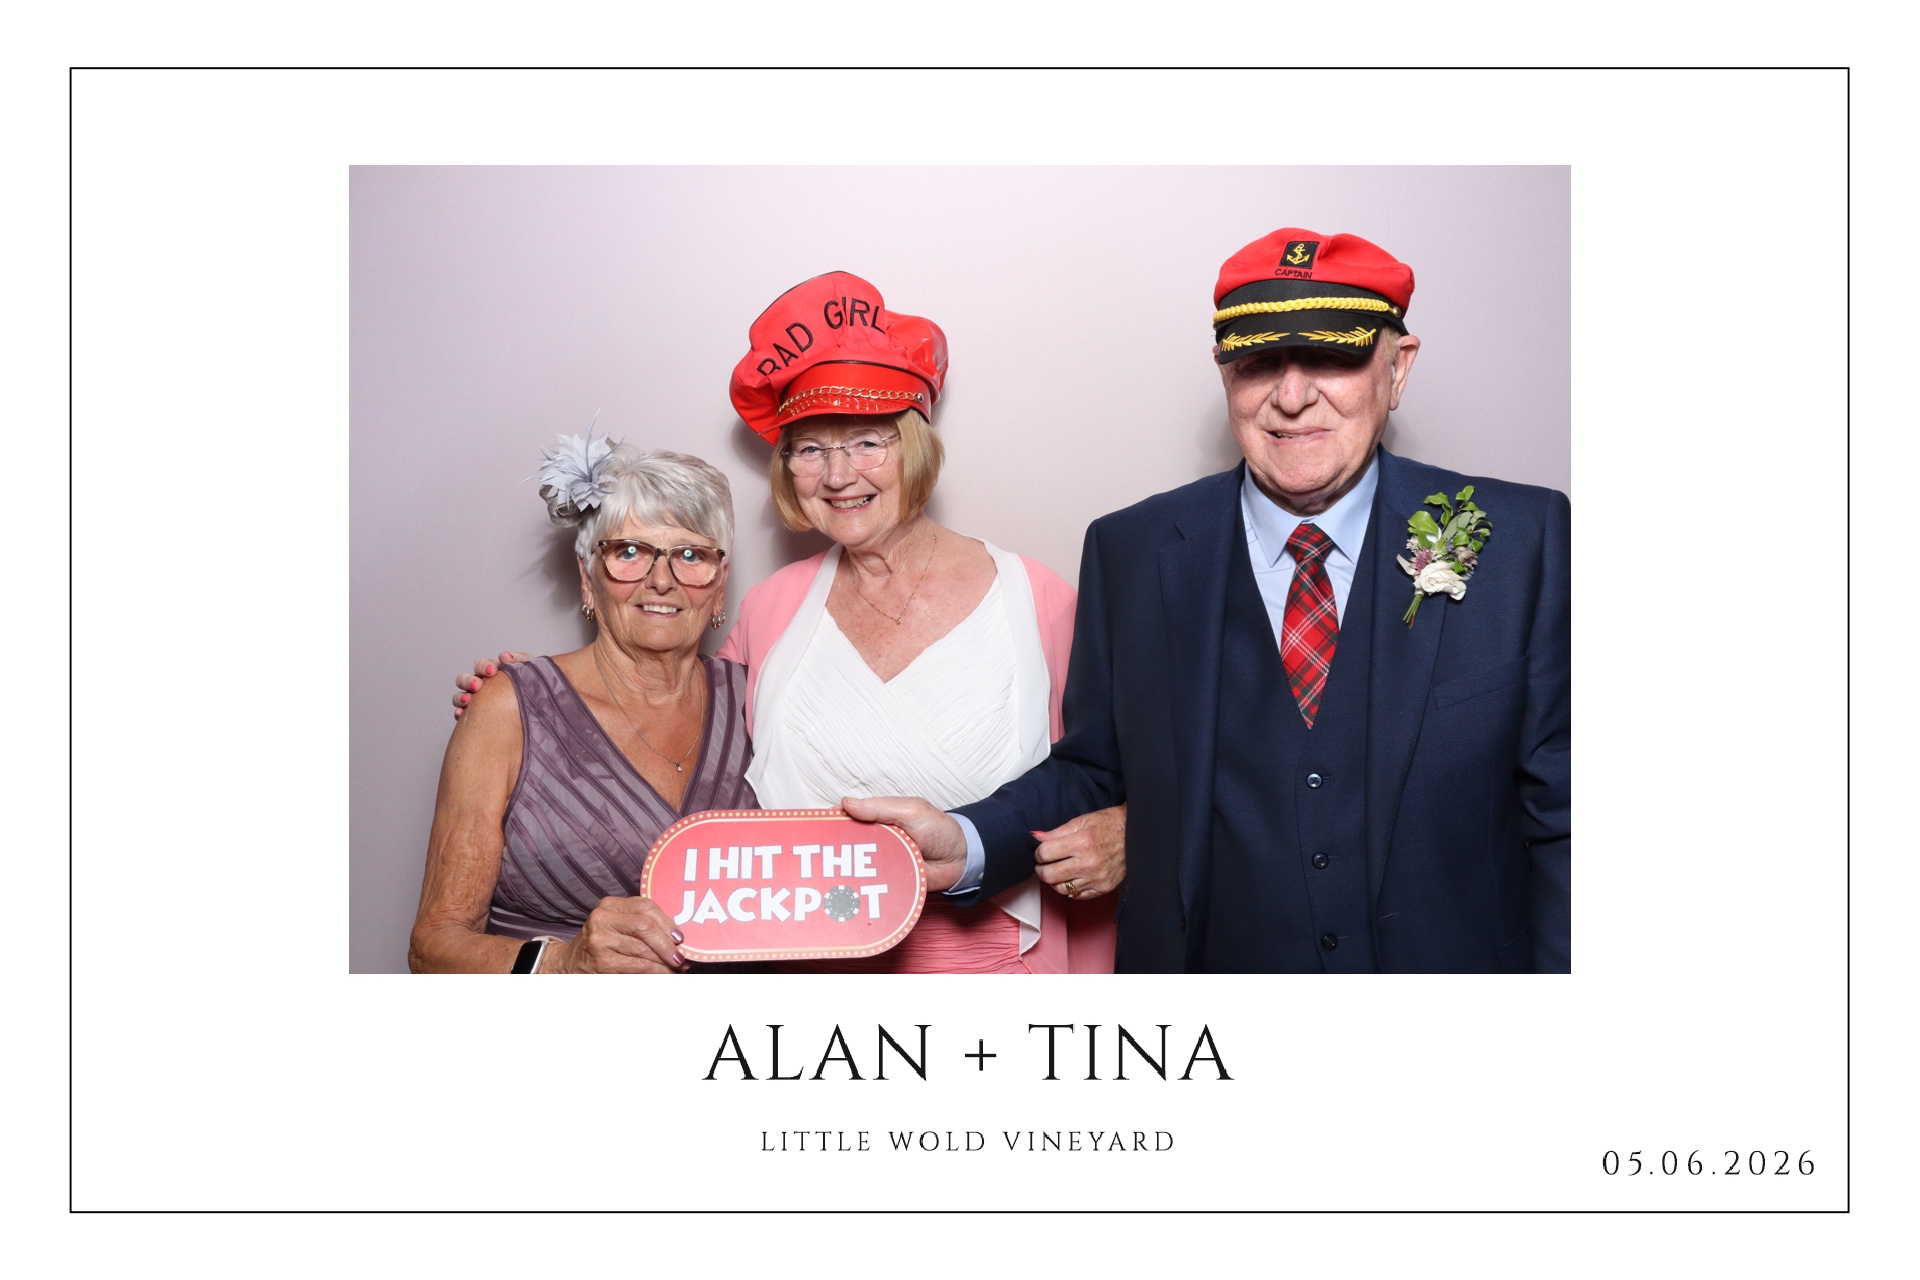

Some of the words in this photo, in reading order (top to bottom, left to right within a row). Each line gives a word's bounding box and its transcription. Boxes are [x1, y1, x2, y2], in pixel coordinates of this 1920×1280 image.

[1275, 268, 1313, 279] CAPTAIN
[824, 296, 886, 335] GIRL
[683, 848, 698, 882] I
[708, 845, 782, 880] HIT
[792, 843, 877, 879] THE
[674, 884, 888, 925] JACKPOT
